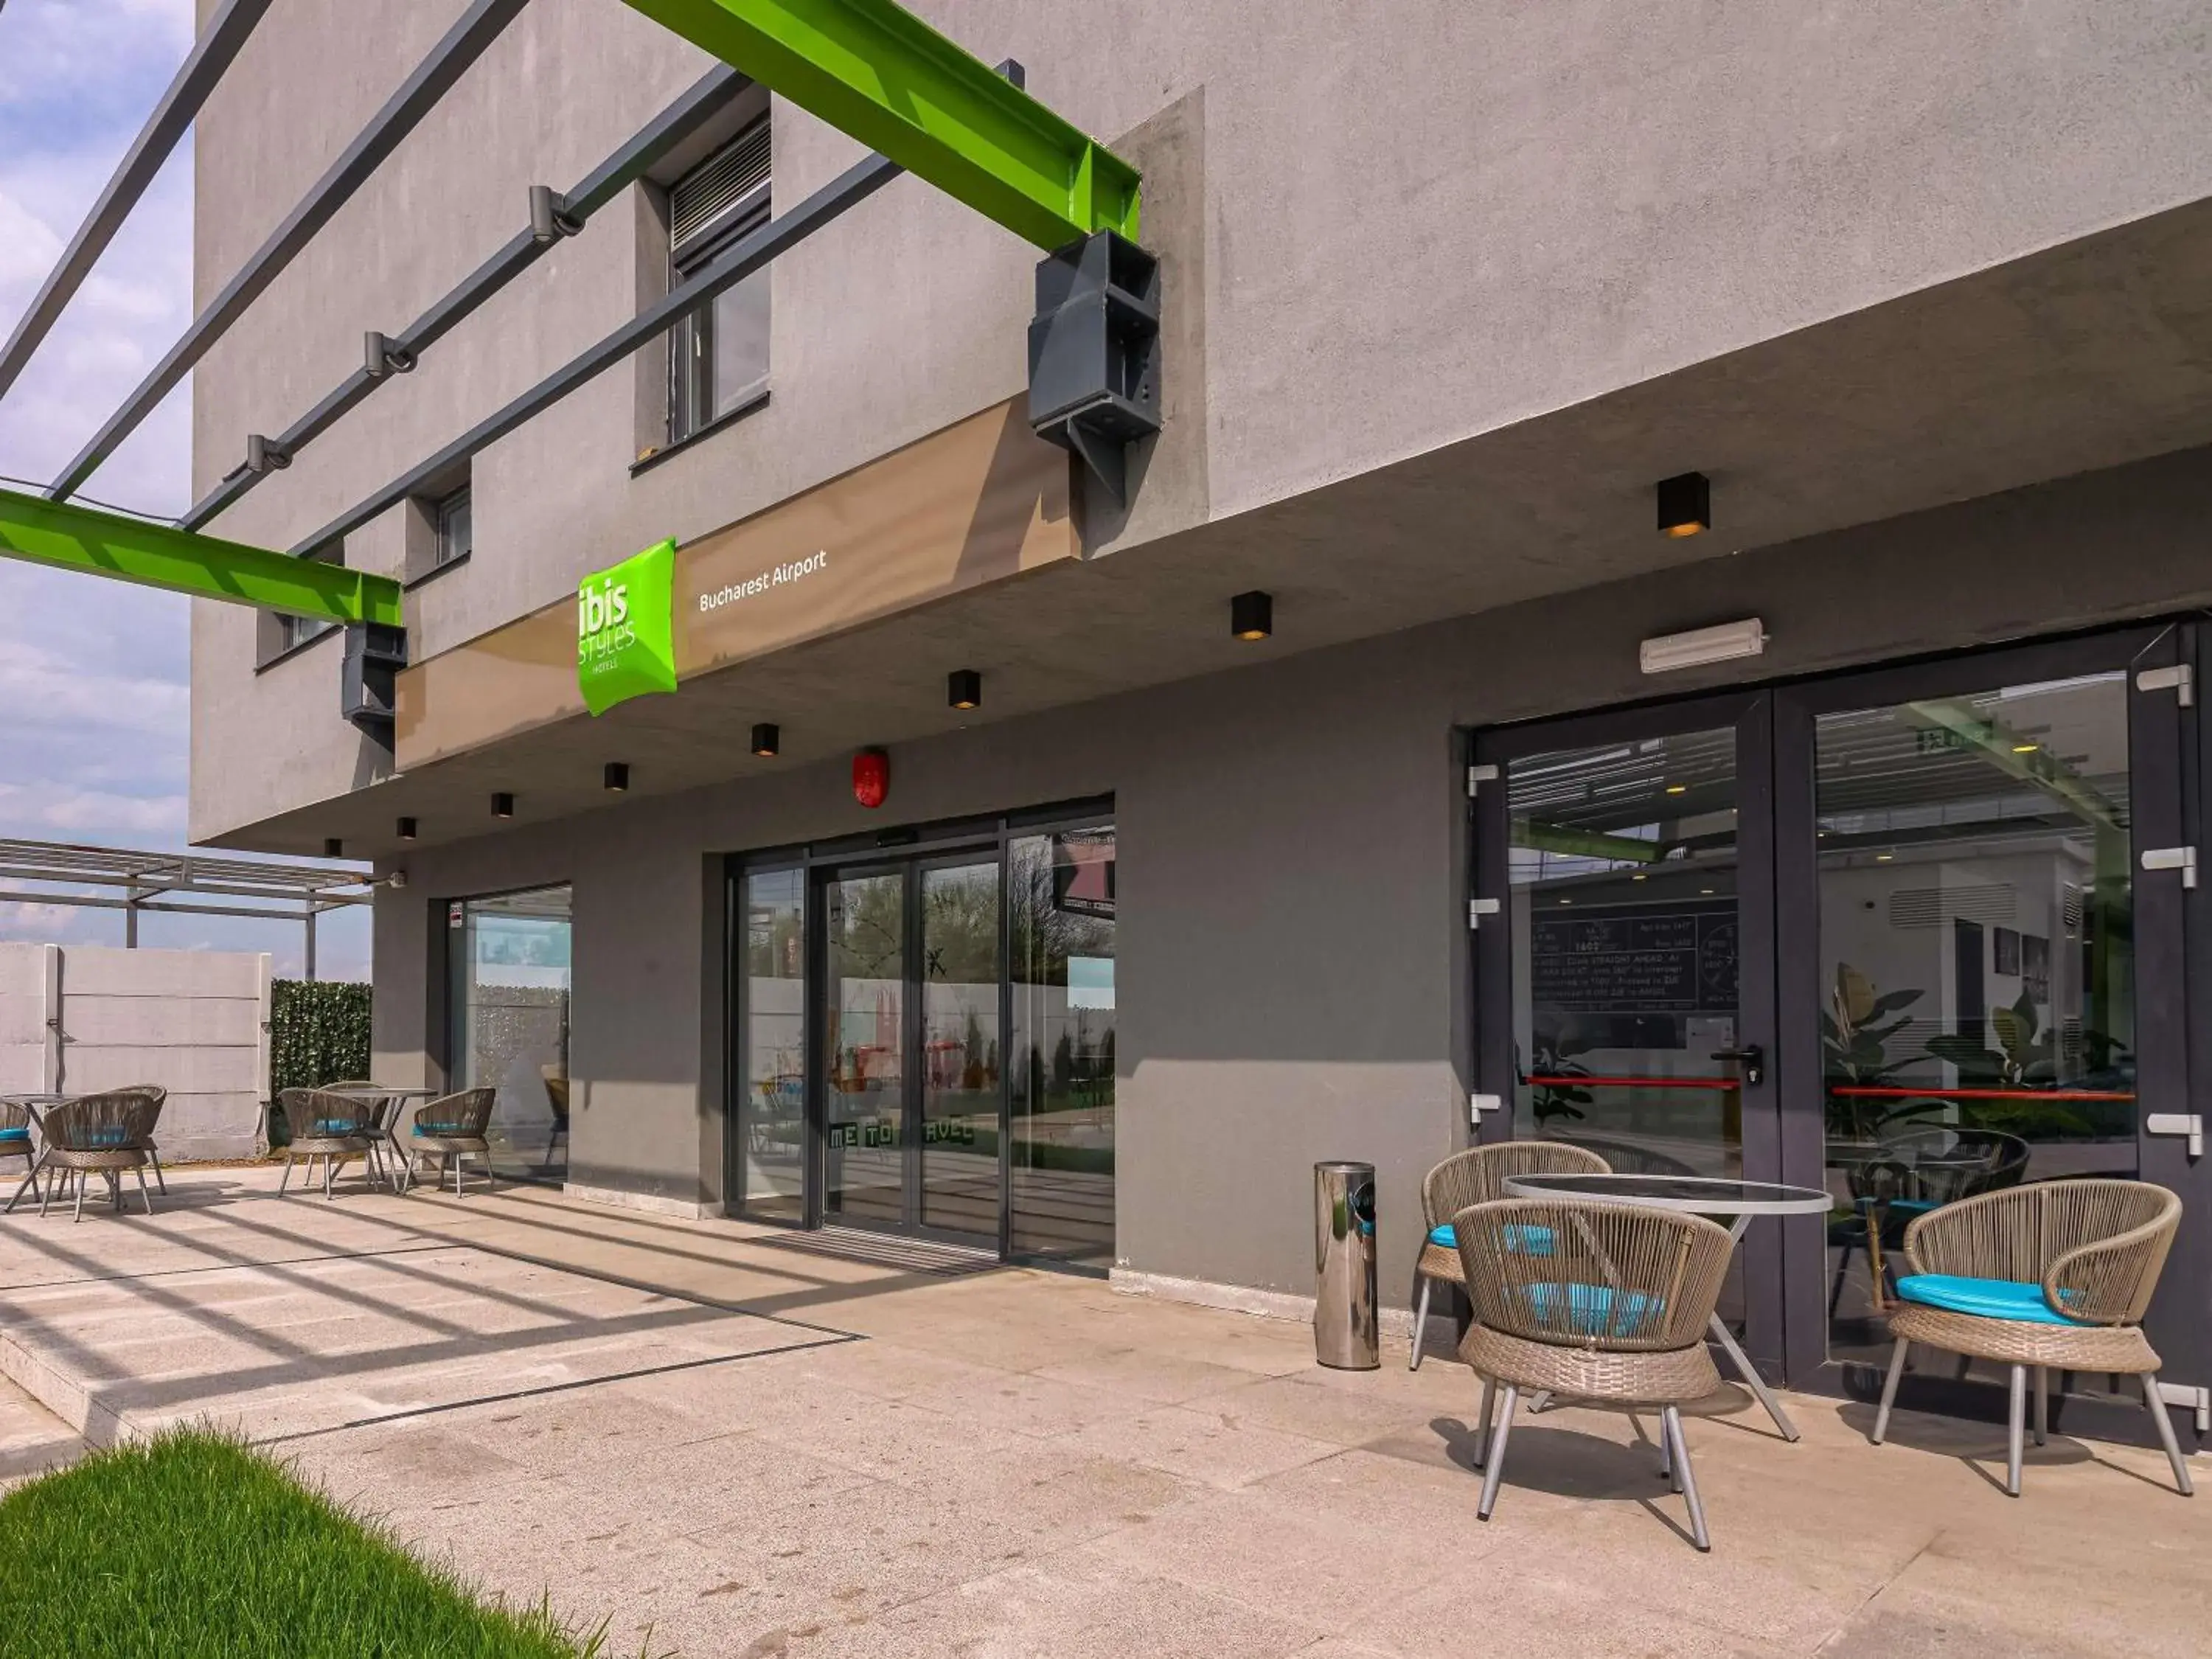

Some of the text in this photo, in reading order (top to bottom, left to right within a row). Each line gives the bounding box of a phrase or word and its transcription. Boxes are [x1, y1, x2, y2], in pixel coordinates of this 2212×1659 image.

[579, 577, 627, 638] ibis
[700, 549, 827, 612] Bucharest Airport
